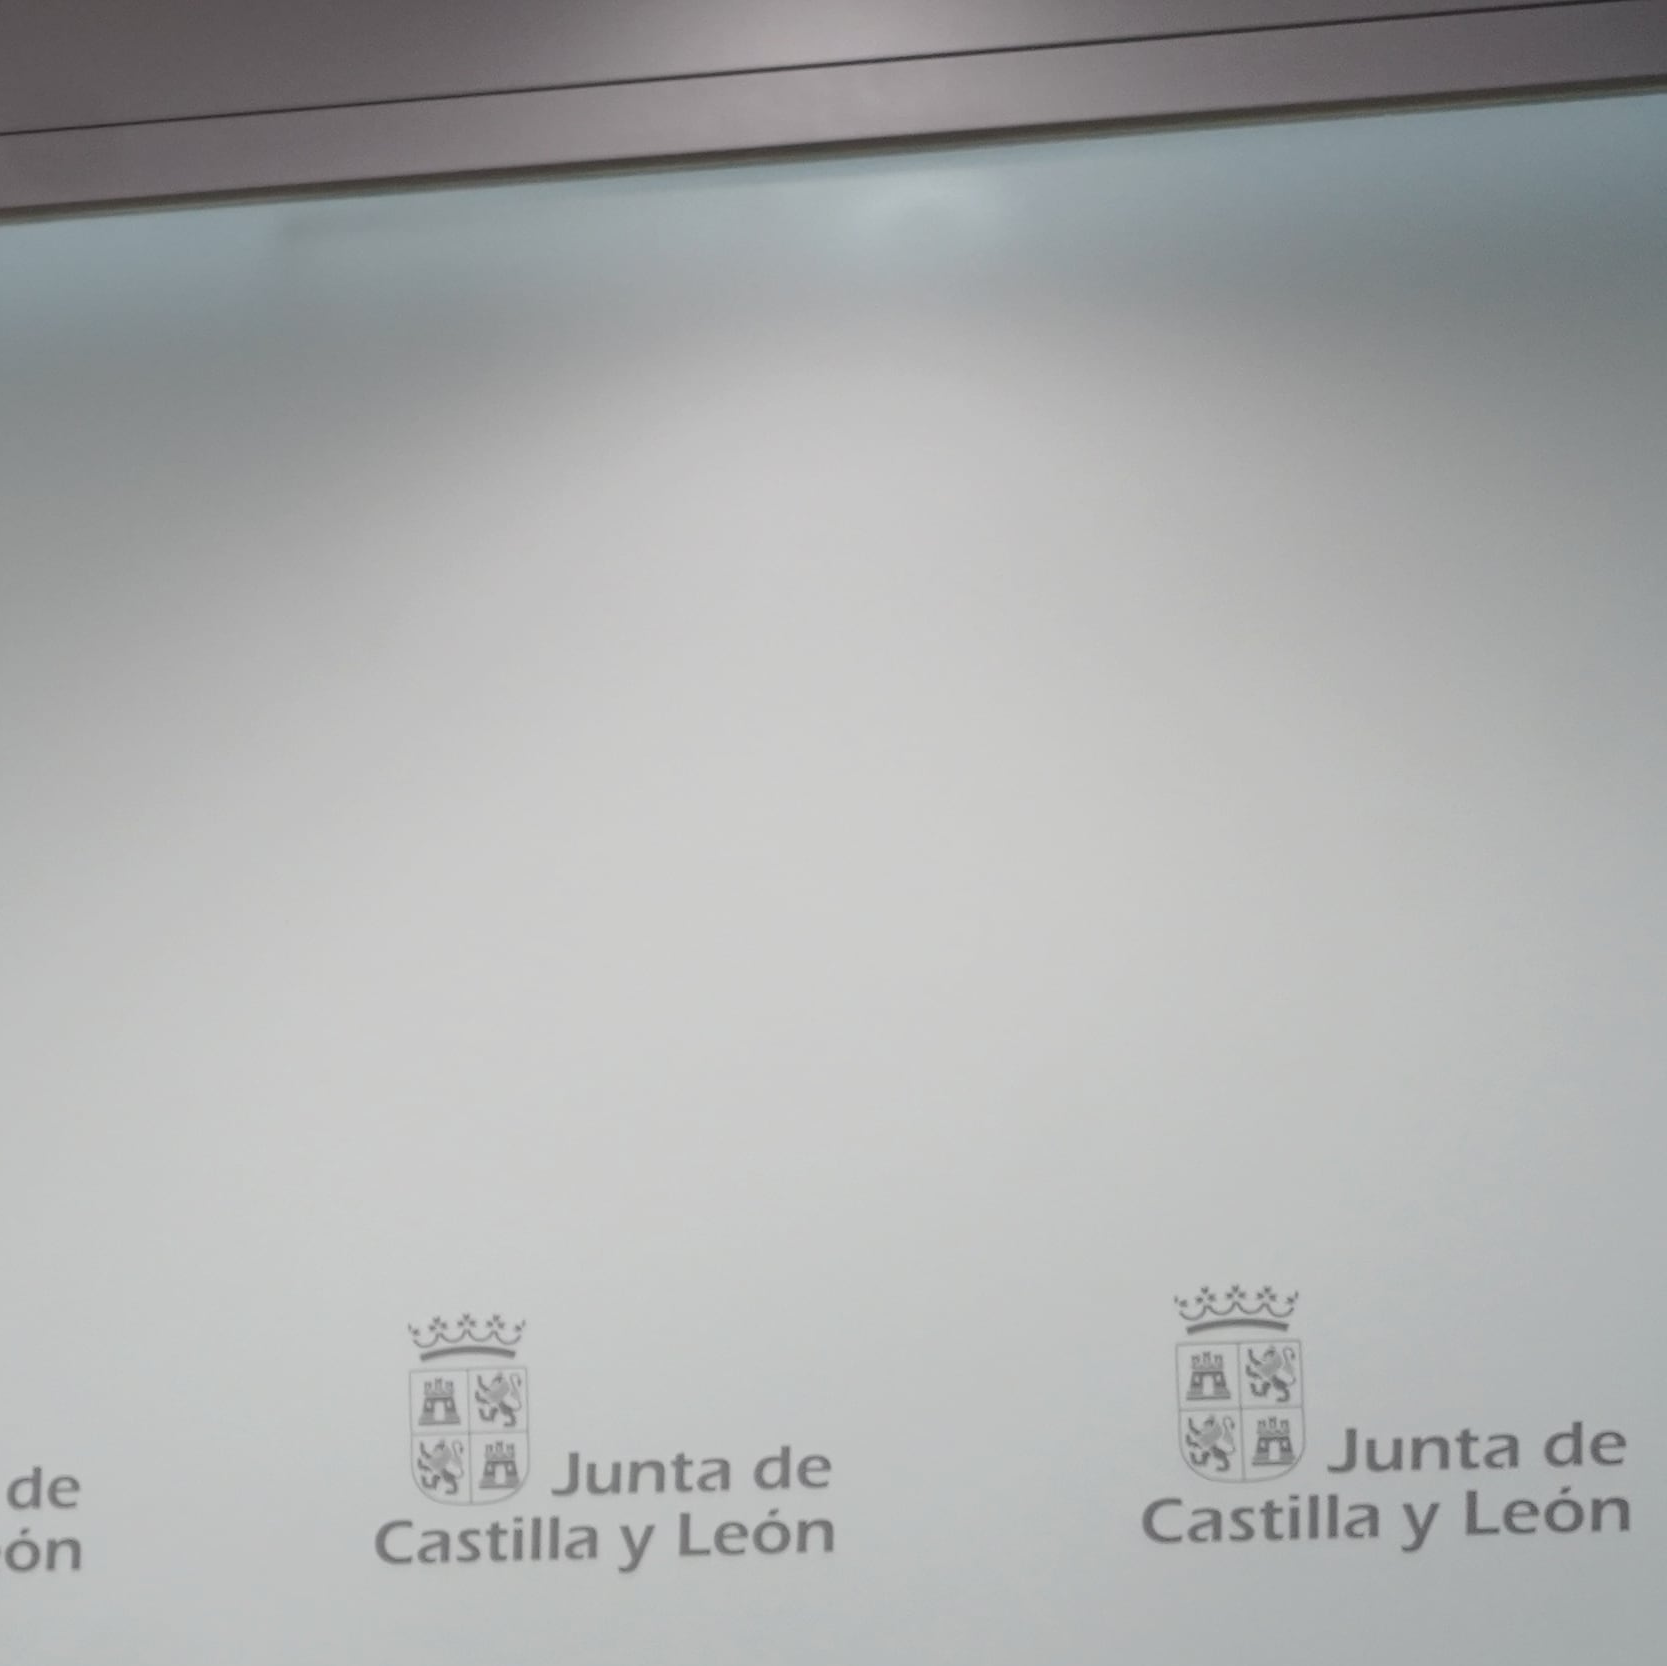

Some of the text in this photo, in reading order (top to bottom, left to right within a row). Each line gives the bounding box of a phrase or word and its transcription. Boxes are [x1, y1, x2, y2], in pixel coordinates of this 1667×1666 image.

[550, 1444, 833, 1498] Junta de
[1326, 1420, 1628, 1475] Junta de
[6, 1465, 81, 1511] de
[374, 1506, 835, 1575] Castilla y León
[1141, 1483, 1632, 1555] Castilla y León
